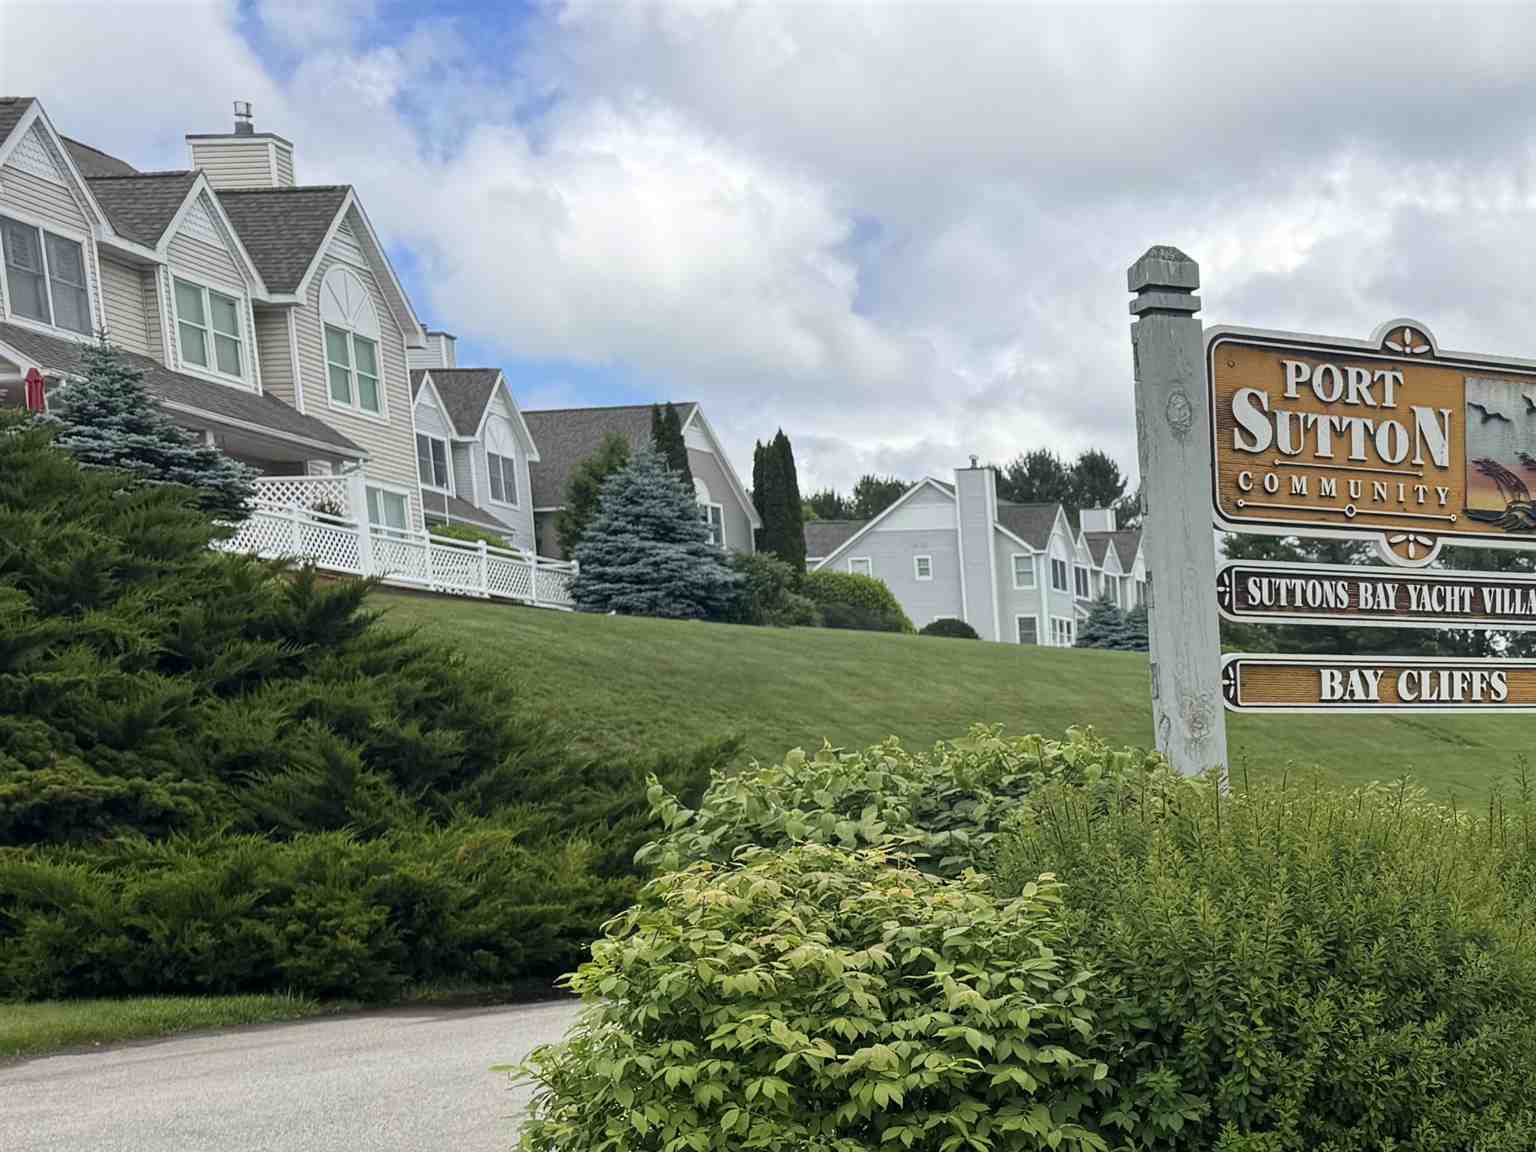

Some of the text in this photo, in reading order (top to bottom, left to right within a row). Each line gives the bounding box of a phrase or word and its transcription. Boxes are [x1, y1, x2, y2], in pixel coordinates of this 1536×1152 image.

[1281, 359, 1404, 408] PORT
[1231, 386, 1453, 467] SUTTON
[1238, 471, 1450, 505] COMMUNITY
[1247, 576, 1349, 610] SUTTONS
[1358, 581, 1400, 612] BAY
[1407, 584, 1475, 615] YACHT
[1320, 668, 1508, 701] BAY CLIFFS
